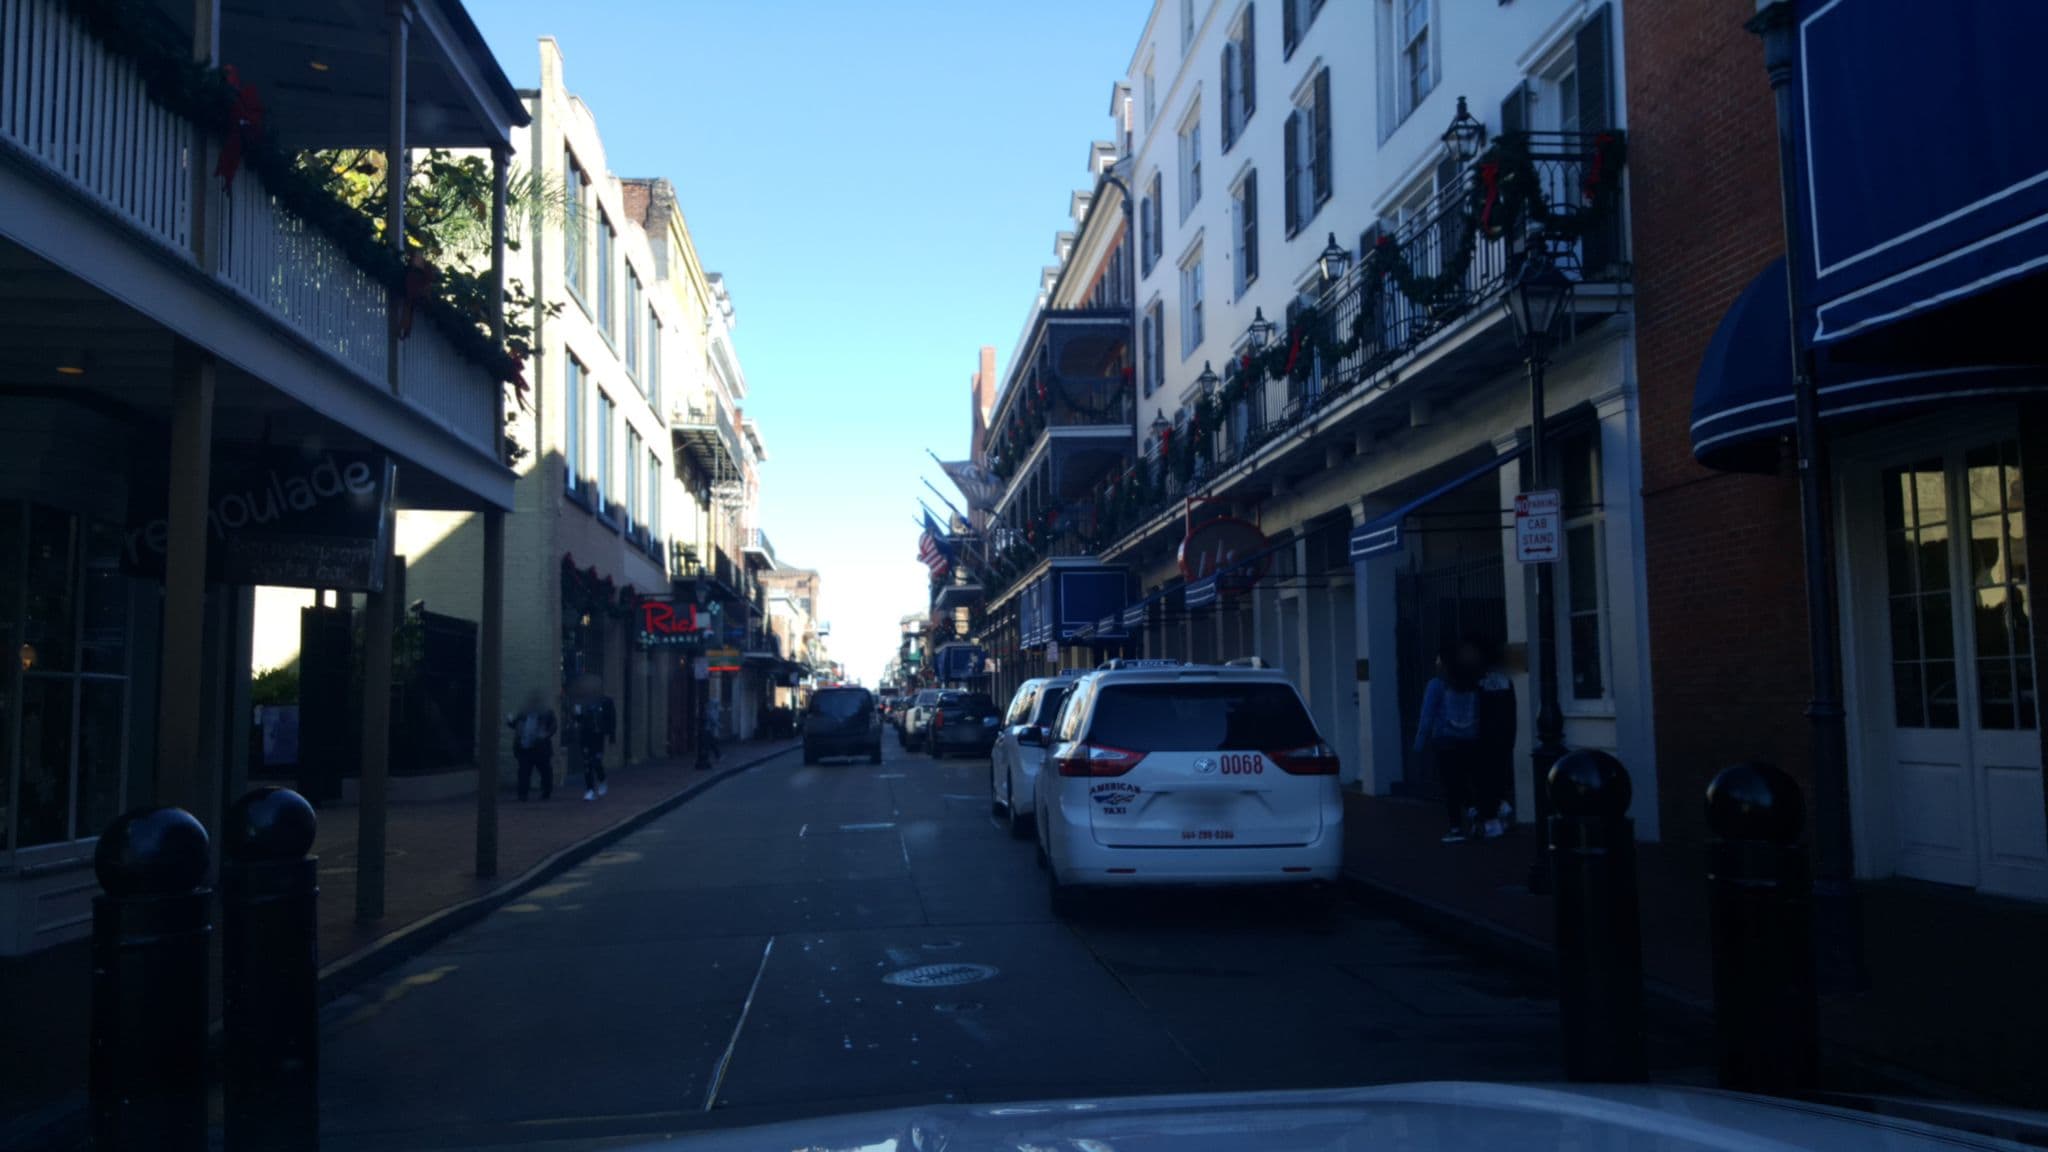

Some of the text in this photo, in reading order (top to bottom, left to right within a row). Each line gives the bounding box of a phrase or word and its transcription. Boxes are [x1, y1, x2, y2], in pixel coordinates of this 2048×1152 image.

[121, 453, 376, 567] reoulade
[1515, 500, 1528, 513] NO
[1528, 518, 1547, 529] CAB
[1523, 533, 1552, 545] STAND
[1220, 754, 1264, 775] 0068
[1089, 783, 1141, 794] AMERICAN
[1104, 807, 1127, 815] TAXI
